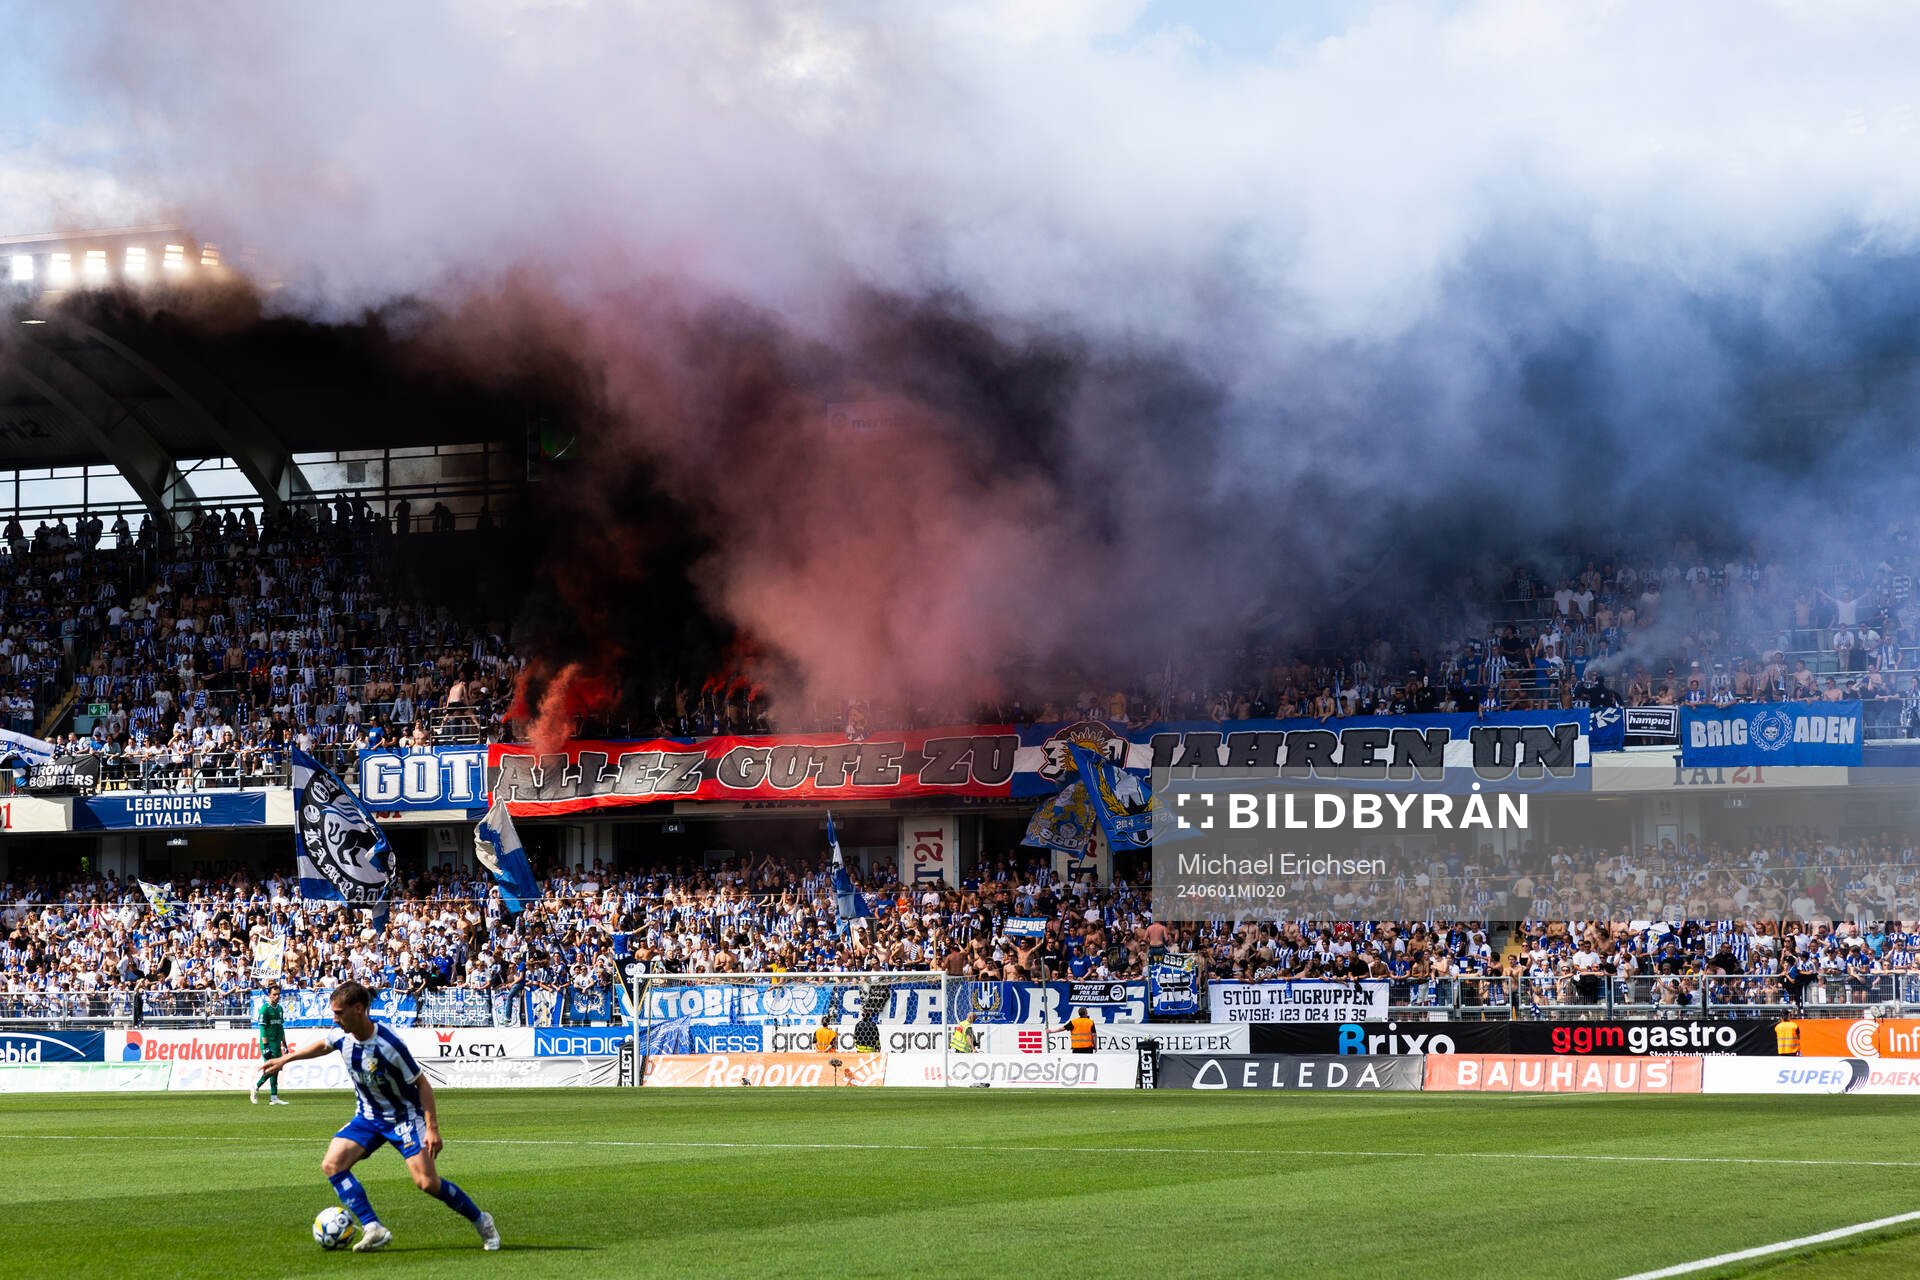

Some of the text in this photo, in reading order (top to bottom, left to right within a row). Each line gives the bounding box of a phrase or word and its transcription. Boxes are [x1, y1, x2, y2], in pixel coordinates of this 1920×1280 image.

[1629, 716, 1670, 726] hampus
[1690, 716, 1857, 748] BRIG ADEN
[30, 764, 76, 775] BROWN
[494, 750, 706, 802] ALLEZ
[919, 734, 1020, 786] ZU
[1144, 722, 1451, 792] JAHREN
[1469, 721, 1580, 781] UN
[29, 774, 94, 787] BOMBERS
[363, 747, 488, 803] GÖT
[126, 796, 212, 812] LEGENDENS
[135, 812, 202, 826] UTVALDA
[668, 824, 679, 832] G4
[1223, 986, 1261, 1006] STÖD
[1229, 1008, 1367, 1022] SWISH: 123 024 15 39
[1098, 1035, 1232, 1050] FASTGHETER
[1338, 1022, 1456, 1055] Brixo
[703, 1055, 823, 1087] Renova
[1243, 1062, 1381, 1088] ELEDA
[1457, 1060, 1668, 1088] BAUHAUS
[1776, 1069, 1845, 1086] SUPER
